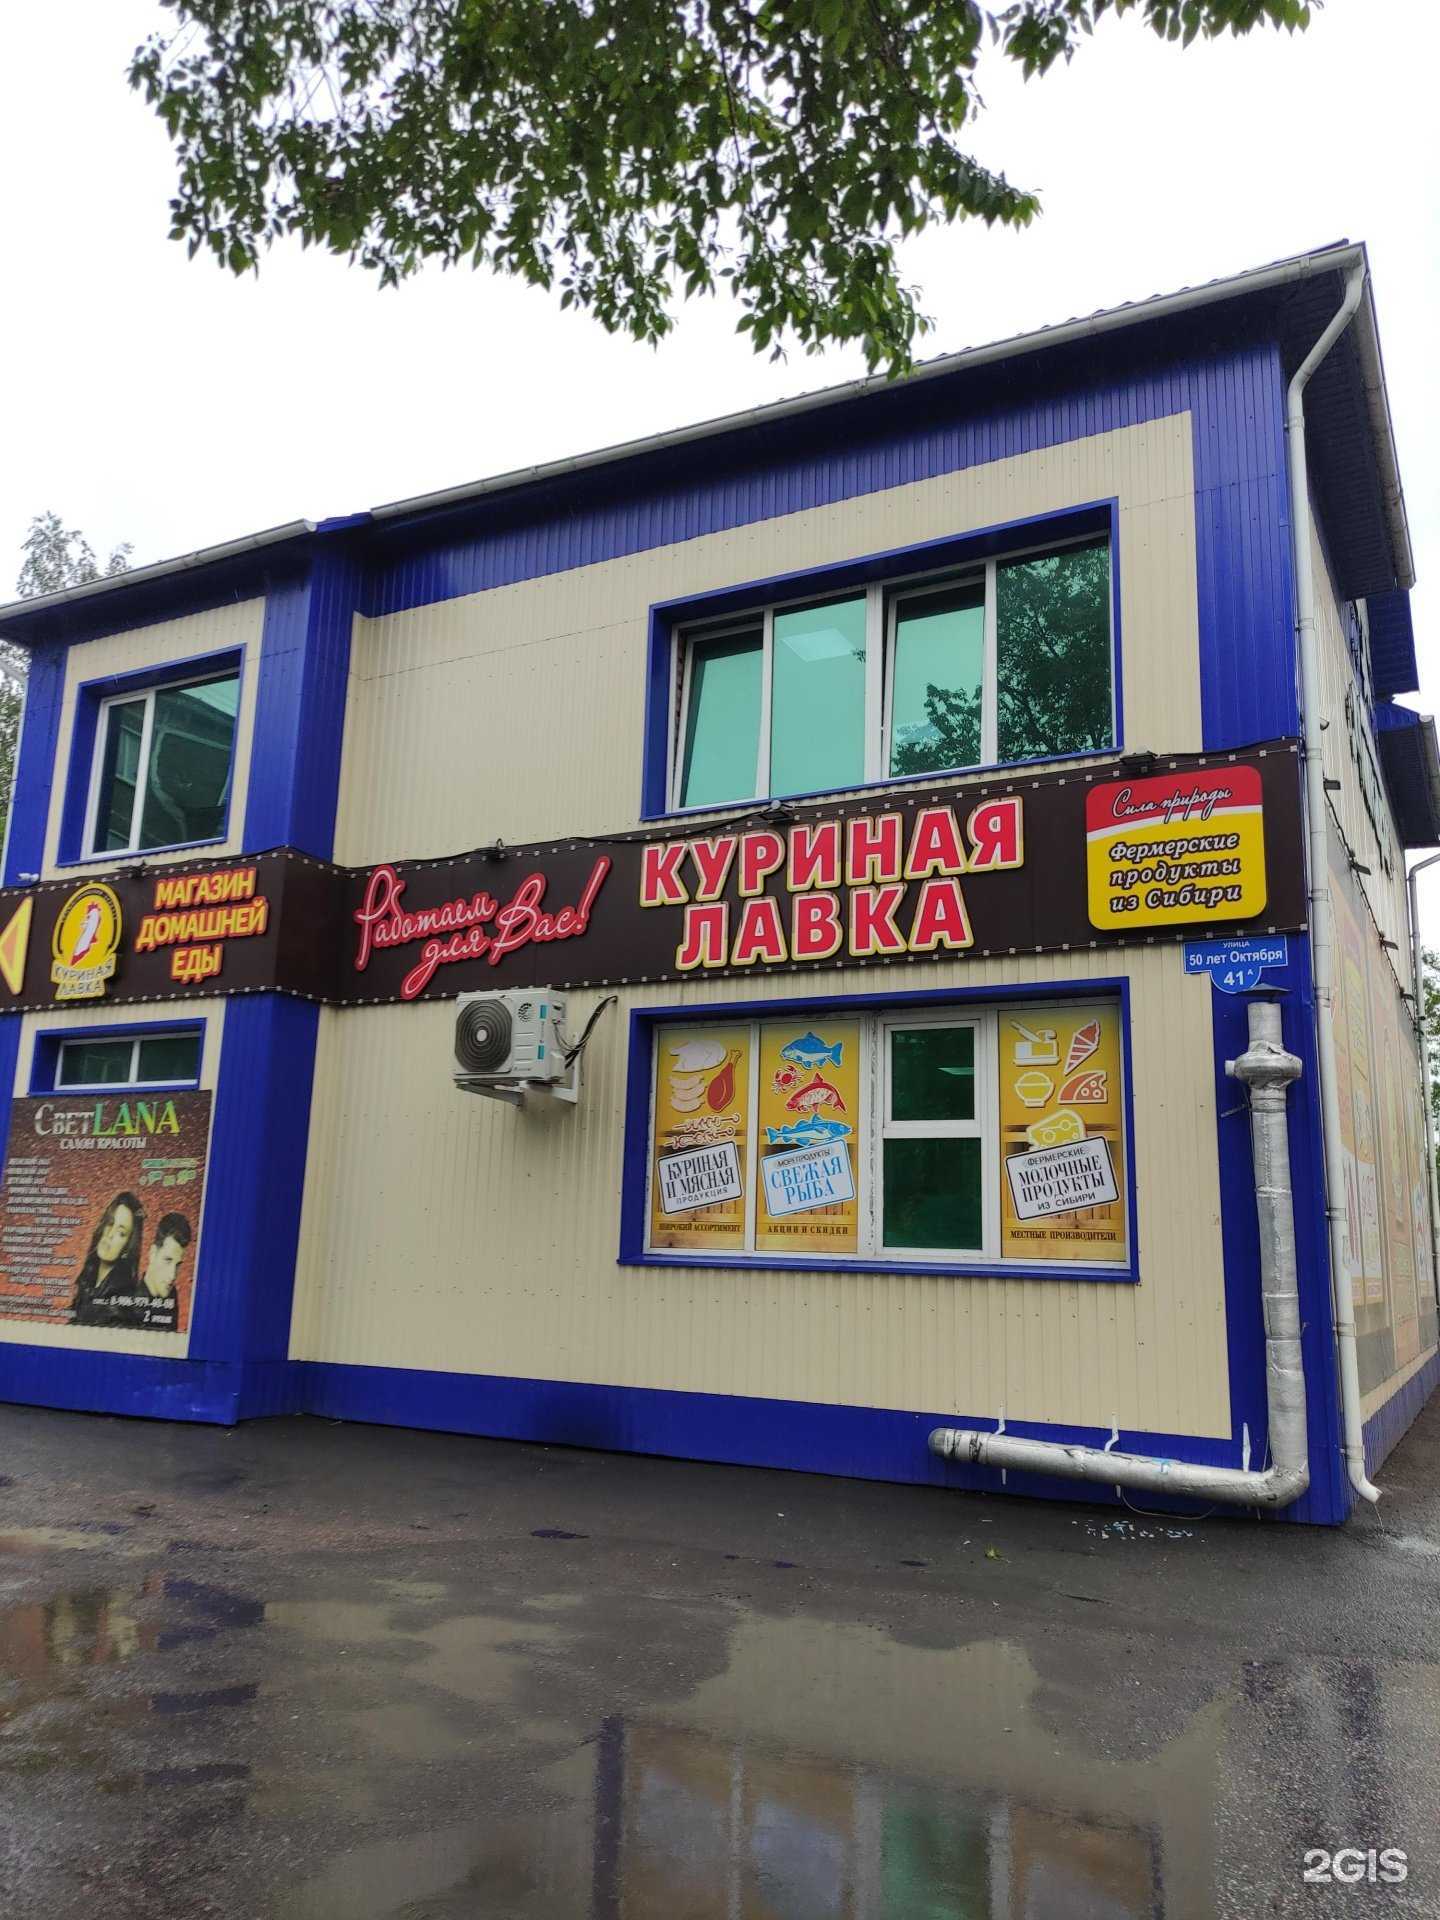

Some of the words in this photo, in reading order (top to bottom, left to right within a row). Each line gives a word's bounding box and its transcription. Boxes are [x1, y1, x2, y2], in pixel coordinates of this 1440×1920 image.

[1111, 787, 1157, 818] Сила
[1160, 787, 1232, 824] природы
[640, 795, 1023, 907] КУРИНАЯ
[1109, 833, 1240, 863] Фермерские
[1110, 858, 1241, 888] продукты
[156, 868, 257, 910] МАГАЗИН
[1110, 895, 1139, 912] из
[1146, 885, 1242, 908] Сибири
[135, 896, 268, 952] ДОМАШНЕЙ
[354, 864, 497, 971] Работаем
[400, 925, 490, 999] для
[488, 855, 612, 965] Вас!
[675, 877, 974, 971] ЛАВКА
[171, 945, 223, 983] ЕДЫ
[1189, 954, 1203, 966] 50
[1206, 954, 1226, 965] лет
[1230, 948, 1283, 963] Октября
[667, 1150, 729, 1181] КУРИНАЯ
[1019, 1155, 1102, 1186] МОЛОЧНЫЕ
[1027, 1147, 1088, 1166] ФЕРМЕРСКИЕ
[666, 1182, 676, 1199] И
[680, 1167, 736, 1196] МЯСНАЯ
[771, 1156, 842, 1189] СВЕЖАЯ
[1022, 1171, 1105, 1203] ПРОДУКТЫ
[676, 1187, 728, 1205] ПРОДУКЦИЯ
[784, 1178, 835, 1205] РЫБА
[1038, 1201, 1051, 1211] ИЗ
[1055, 1192, 1096, 1207] СИБИРИ
[768, 1225, 798, 1233] АКЦИИ
[801, 1225, 807, 1233] И
[810, 1225, 848, 1234] СКИДКИ
[1011, 1230, 1047, 1239] МЕСТНЫЕ
[1050, 1231, 1117, 1241] ПРОИЗВОДИТЕЛИ
